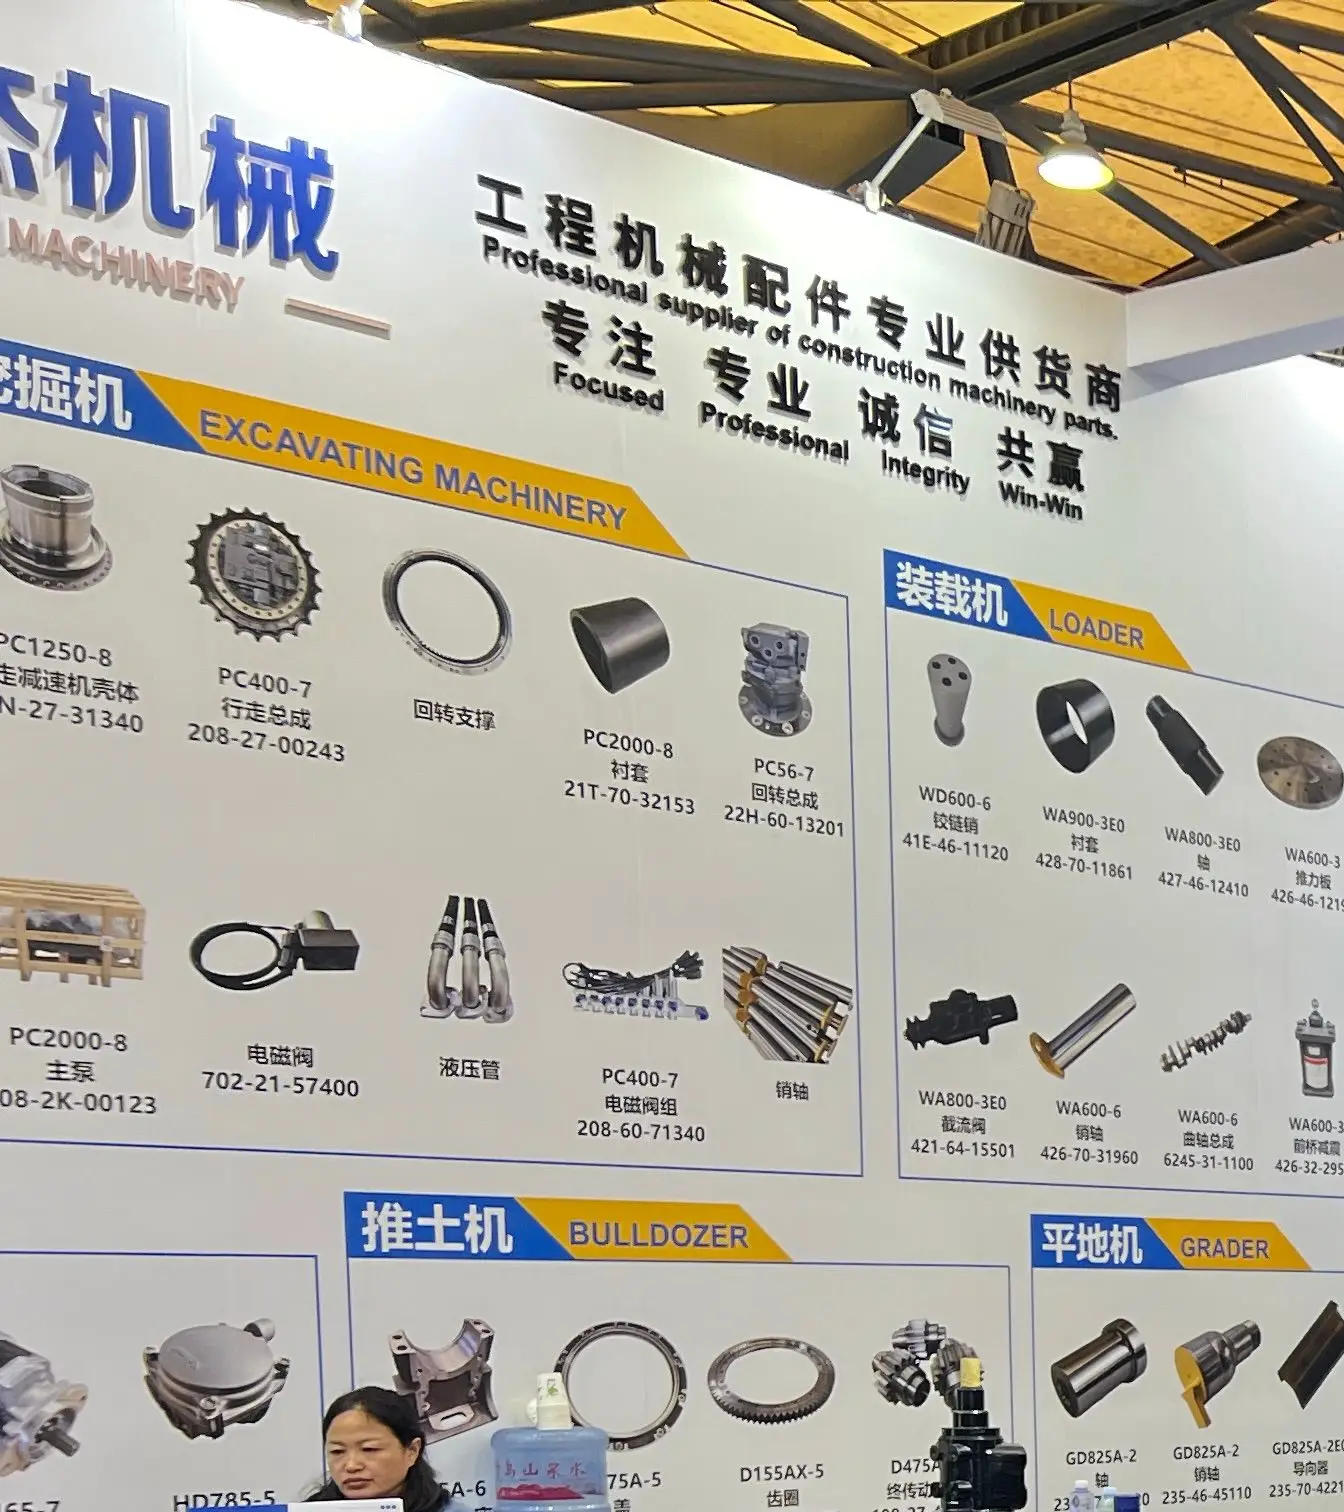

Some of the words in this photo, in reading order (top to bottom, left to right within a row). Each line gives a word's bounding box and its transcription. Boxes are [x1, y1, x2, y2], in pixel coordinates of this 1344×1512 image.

[8, 216, 246, 307] MACHINERY
[475, 173, 1123, 415] 工程机械配件专业供货商
[482, 235, 649, 305] Professional
[658, 289, 760, 338] supplier
[766, 321, 791, 348] of
[798, 331, 942, 392] construction
[948, 373, 1057, 427] machinery
[1063, 409, 1120, 442] parts.
[0, 353, 133, 432] 掘机
[541, 298, 658, 378] 专注
[705, 343, 812, 421] 专业
[856, 386, 955, 459] 诚信
[995, 427, 1086, 494] 共赢
[553, 361, 666, 414] Focused
[699, 400, 851, 463] Professional
[880, 448, 972, 499] Integrity
[997, 479, 1085, 523] Win-Win
[200, 408, 424, 486] EXCAVATING
[434, 462, 629, 533] MACHINERY
[895, 560, 1010, 628] 装载机
[1048, 607, 1146, 652] LOADER
[217, 666, 313, 699] PC400-7
[220, 696, 313, 731] 行走总成
[412, 698, 497, 732] 回转支撑
[187, 723, 347, 763] 208-27-00243
[582, 728, 675, 760] PC2000-8
[610, 759, 650, 784] 衬套
[753, 757, 815, 783] PC56-7
[563, 779, 696, 816] 21T-70-32153
[751, 782, 820, 811] 回转总成
[918, 784, 993, 813] WD600-6
[723, 804, 846, 838] 22H-60-13201
[932, 811, 980, 837] 铰链销
[1042, 805, 1126, 835] WA900-3E0
[902, 832, 1010, 863] 41E-46-11120
[1070, 833, 1100, 855] 衬套
[1164, 825, 1242, 854] WA800-3E0
[1035, 852, 1134, 882] 428-70-11861
[1196, 851, 1212, 873] 轴
[1284, 846, 1342, 870] WA600-3
[1157, 871, 1250, 898] 427-46-12410
[1294, 870, 1333, 893] 推力板
[9, 1026, 129, 1053] PC2000-8
[247, 1043, 315, 1069] 电磁阀
[438, 1056, 501, 1082] 液压管
[45, 1059, 97, 1084] 主泵
[200, 1070, 360, 1099] 702-21-57400
[601, 1068, 680, 1090] PC400-7
[774, 1079, 810, 1102] 销轴
[918, 1089, 1009, 1113] WA800-3E0
[604, 1094, 679, 1118] 电磁阀组
[1055, 1099, 1123, 1120] WA600-6
[1177, 1108, 1240, 1129] WA600-6
[576, 1119, 706, 1143] 208-60-71340
[940, 1114, 987, 1137] 截流阀
[1075, 1123, 1105, 1144] 销轴
[910, 1137, 1017, 1161] 421-64-15501
[1182, 1130, 1235, 1152] 曲轴总成
[1039, 1144, 1140, 1167] 426-70-31960
[1163, 1152, 1255, 1174] 6245-31-1100
[361, 1201, 515, 1255] 推土机
[568, 1220, 750, 1251] BULLDOZER
[1040, 1221, 1145, 1268] 平地机
[1180, 1236, 1271, 1262] GRADER
[1065, 1448, 1138, 1466] GD825A-2
[1172, 1443, 1241, 1461] GD825A-2
[739, 1463, 826, 1484] D155AX-5
[1094, 1471, 1110, 1489] 轴
[1193, 1464, 1221, 1483] 销轴
[1292, 1459, 1330, 1478] 导向器
[440, 1479, 487, 1498] A-6
[766, 1488, 801, 1509] 齿圈
[1161, 1485, 1253, 1505] 235-46-45110
